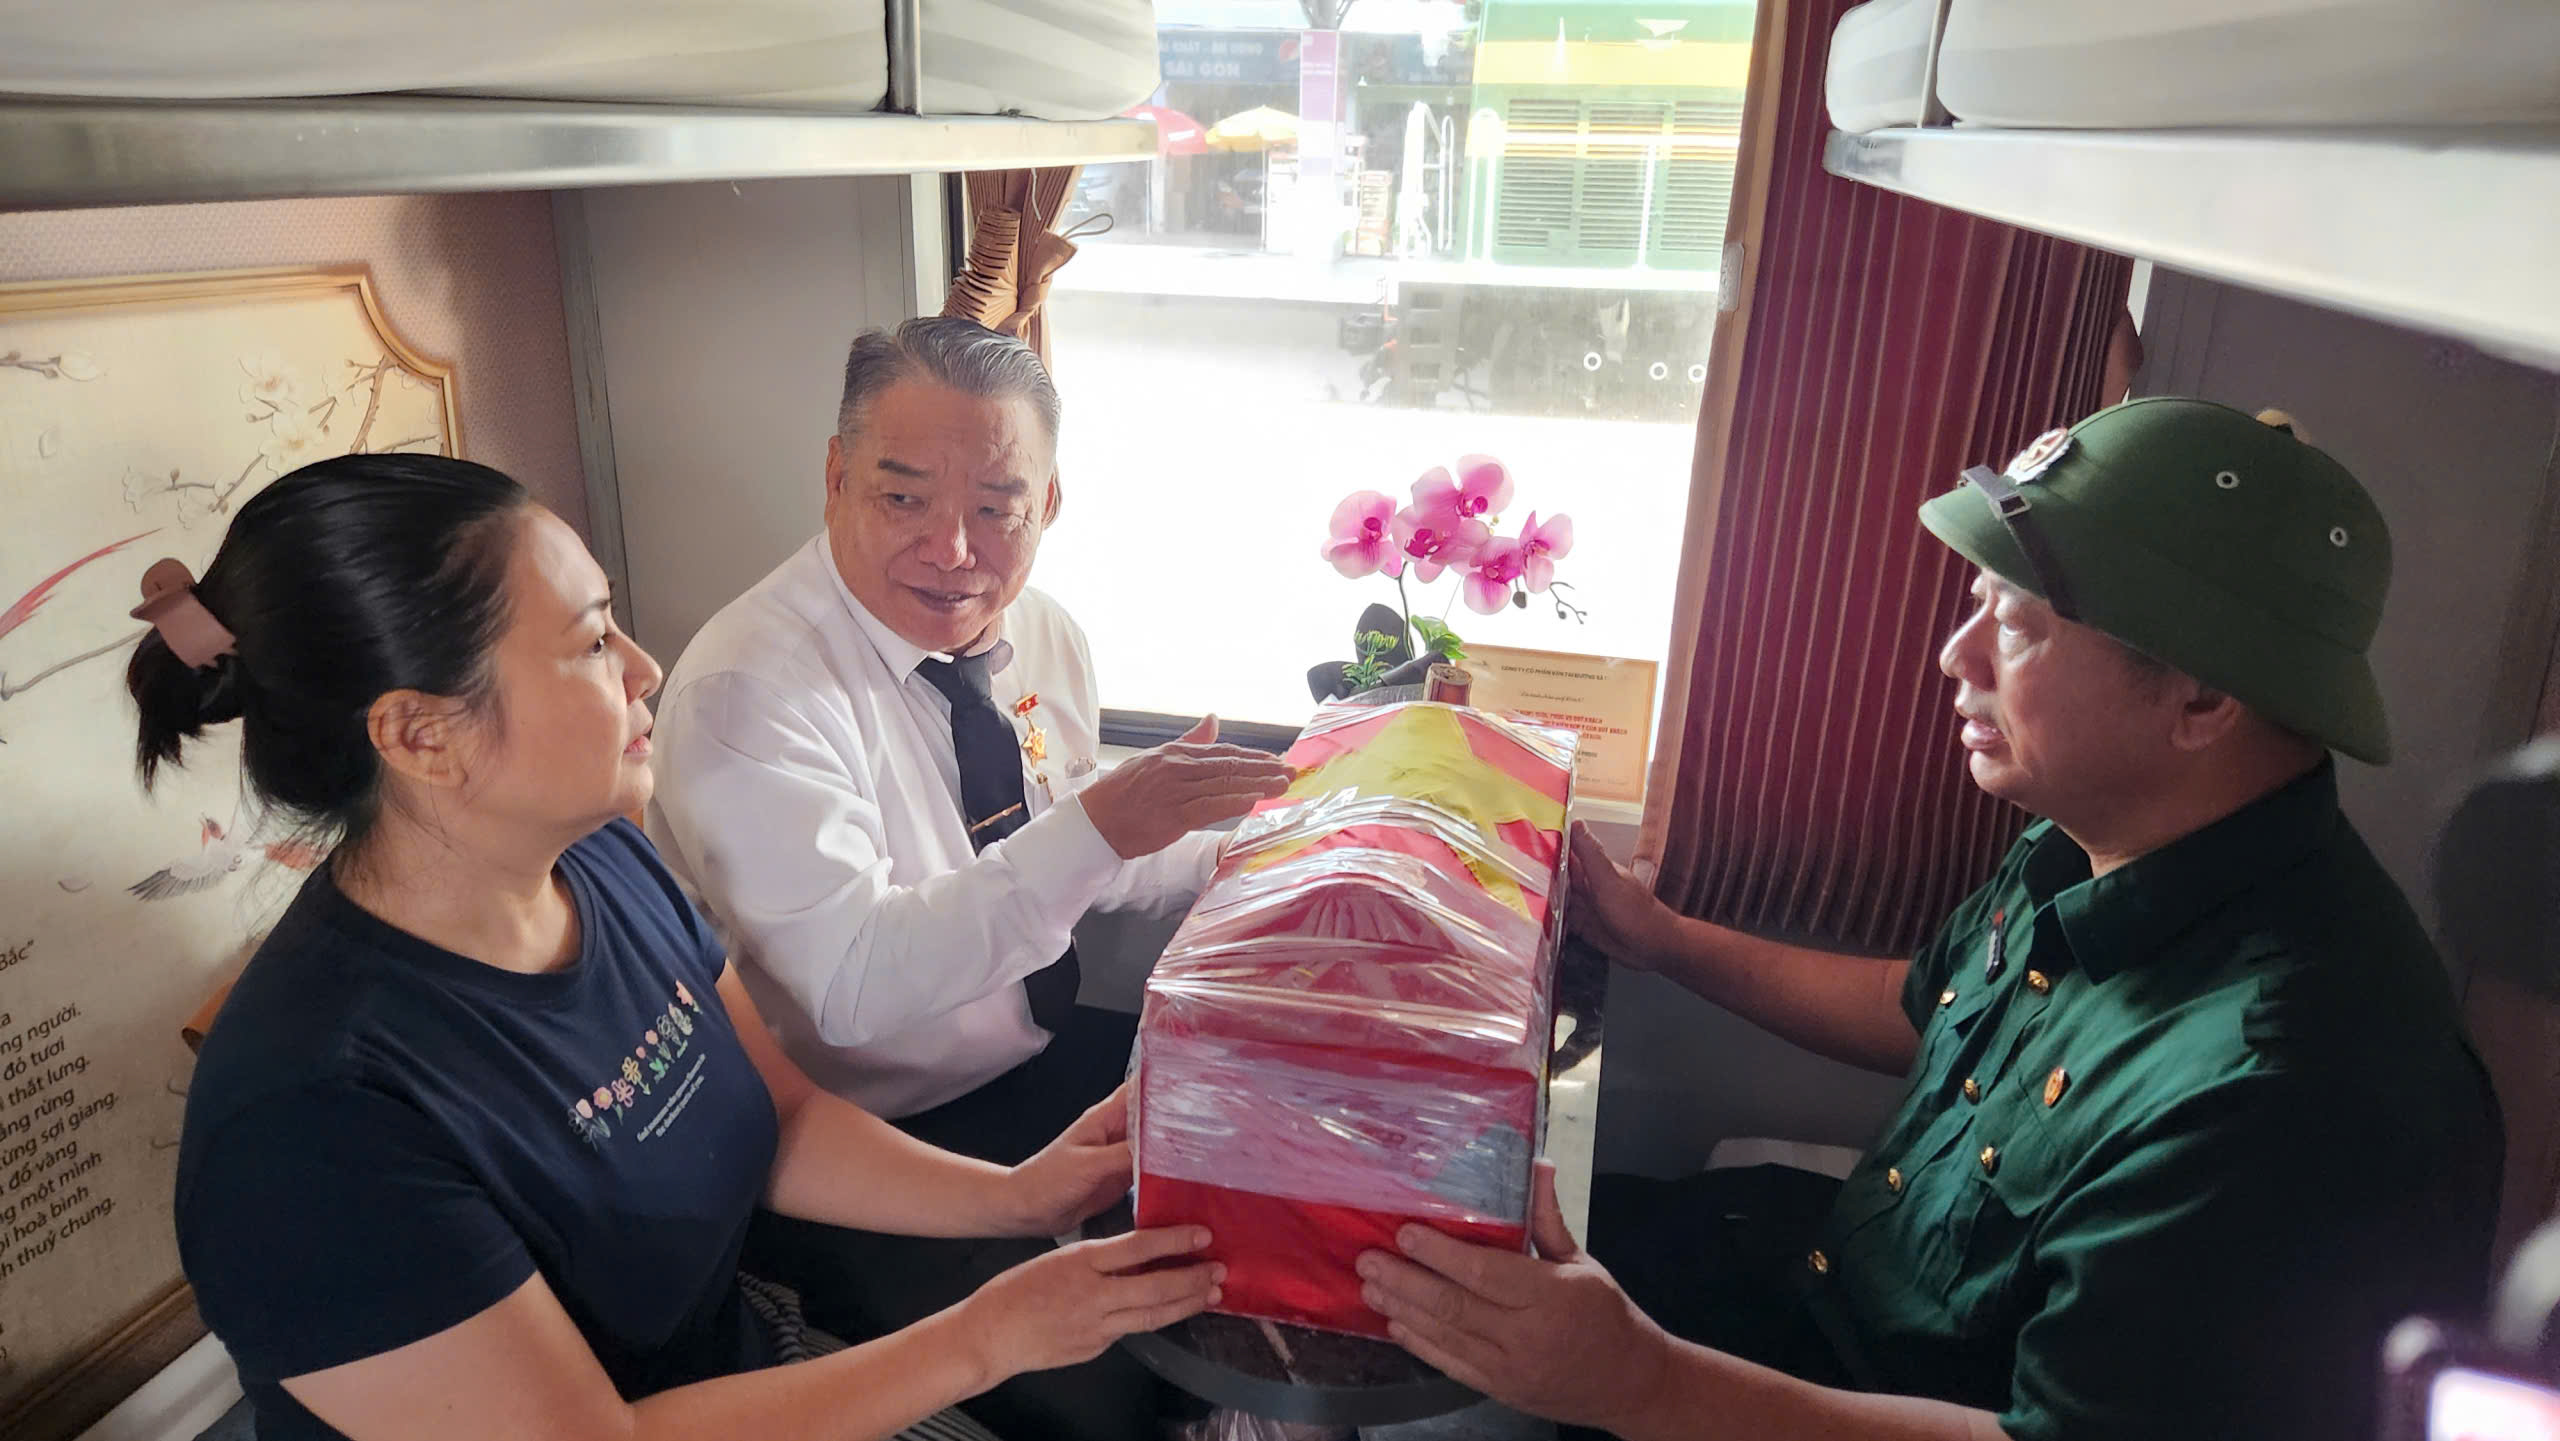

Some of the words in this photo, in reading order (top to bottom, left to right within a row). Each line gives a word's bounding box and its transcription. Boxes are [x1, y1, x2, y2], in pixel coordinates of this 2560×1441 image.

[27, 1003, 81, 1038] người.
[31, 1035, 65, 1066] tươi
[47, 1056, 91, 1085] lưng.
[34, 1089, 74, 1120] rừng
[41, 1118, 65, 1143] sợi
[68, 1092, 119, 1130] giang.
[35, 1141, 77, 1172] vàng
[20, 1180, 54, 1211] một
[59, 1152, 102, 1187] mình
[50, 1185, 89, 1218] bình
[60, 1197, 116, 1239] chung.
